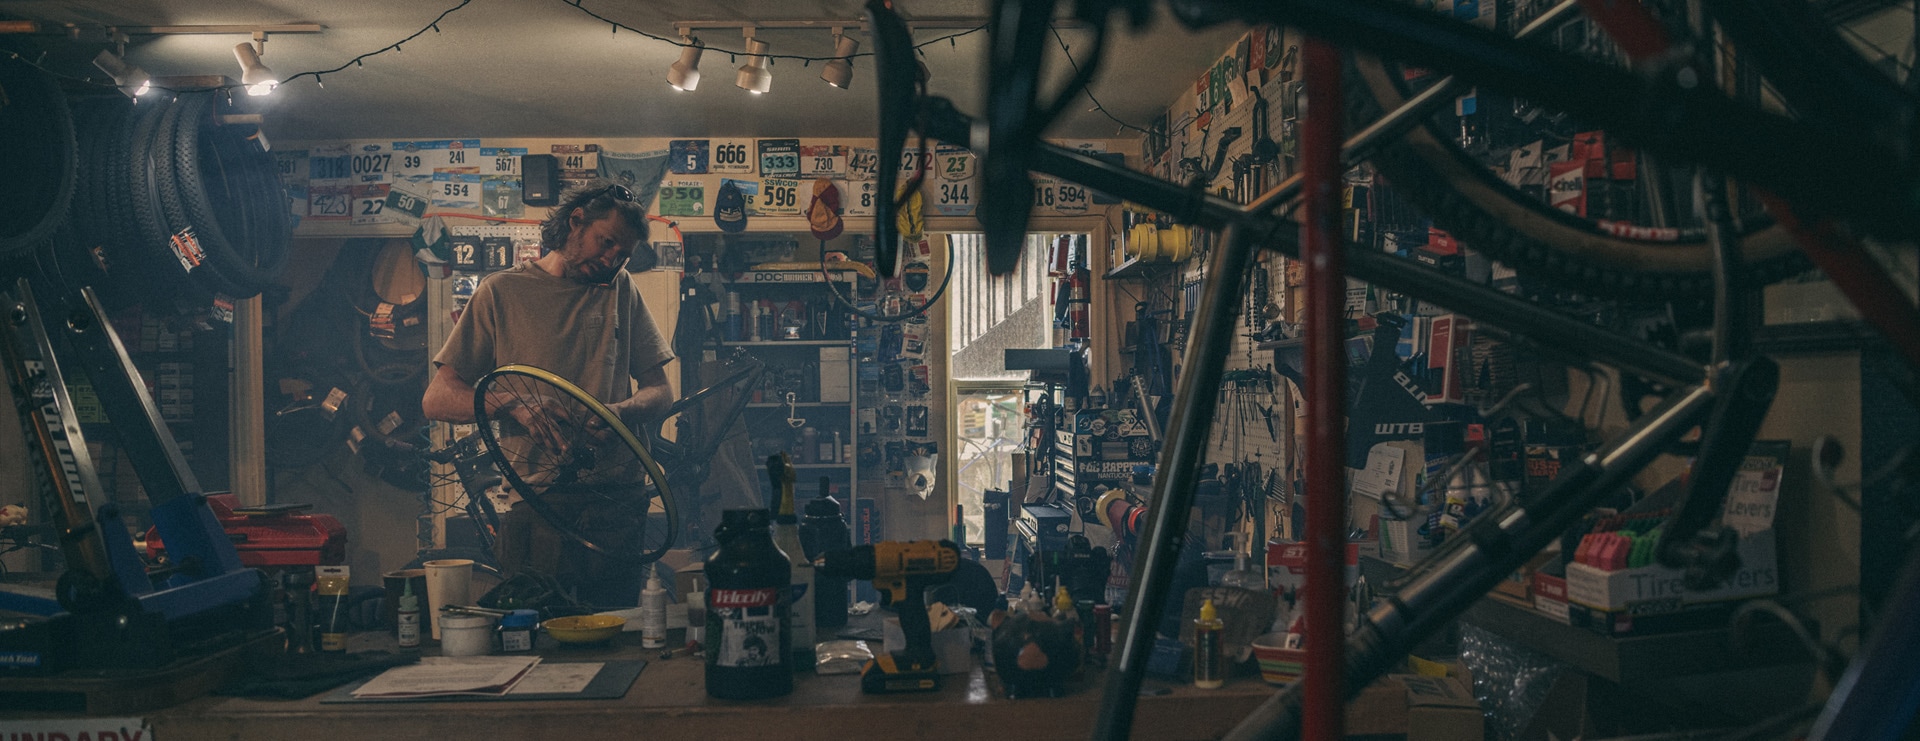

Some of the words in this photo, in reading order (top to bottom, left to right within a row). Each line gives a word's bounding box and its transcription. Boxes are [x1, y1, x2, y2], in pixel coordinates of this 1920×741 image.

[404, 156, 421, 168] 39
[449, 151, 465, 164] 241
[566, 156, 583, 168] 441
[687, 154, 696, 170] 5
[716, 145, 746, 164] 666
[765, 156, 795, 169] 333
[353, 154, 391, 174] 0027
[496, 159, 511, 171] 567
[814, 158, 833, 170] 730
[850, 154, 878, 173] 442
[946, 157, 968, 173] 23
[444, 183, 469, 197] 554
[764, 179, 798, 187] SSWC09
[660, 187, 703, 200] 950
[764, 186, 796, 207] 596
[940, 184, 969, 204] 344
[1058, 186, 1086, 203] 594
[397, 194, 415, 210] 50
[453, 244, 475, 265] 12
[1375, 422, 1425, 435] WTB
[1629, 572, 1685, 598] Tire
[716, 589, 770, 606] Velocity
